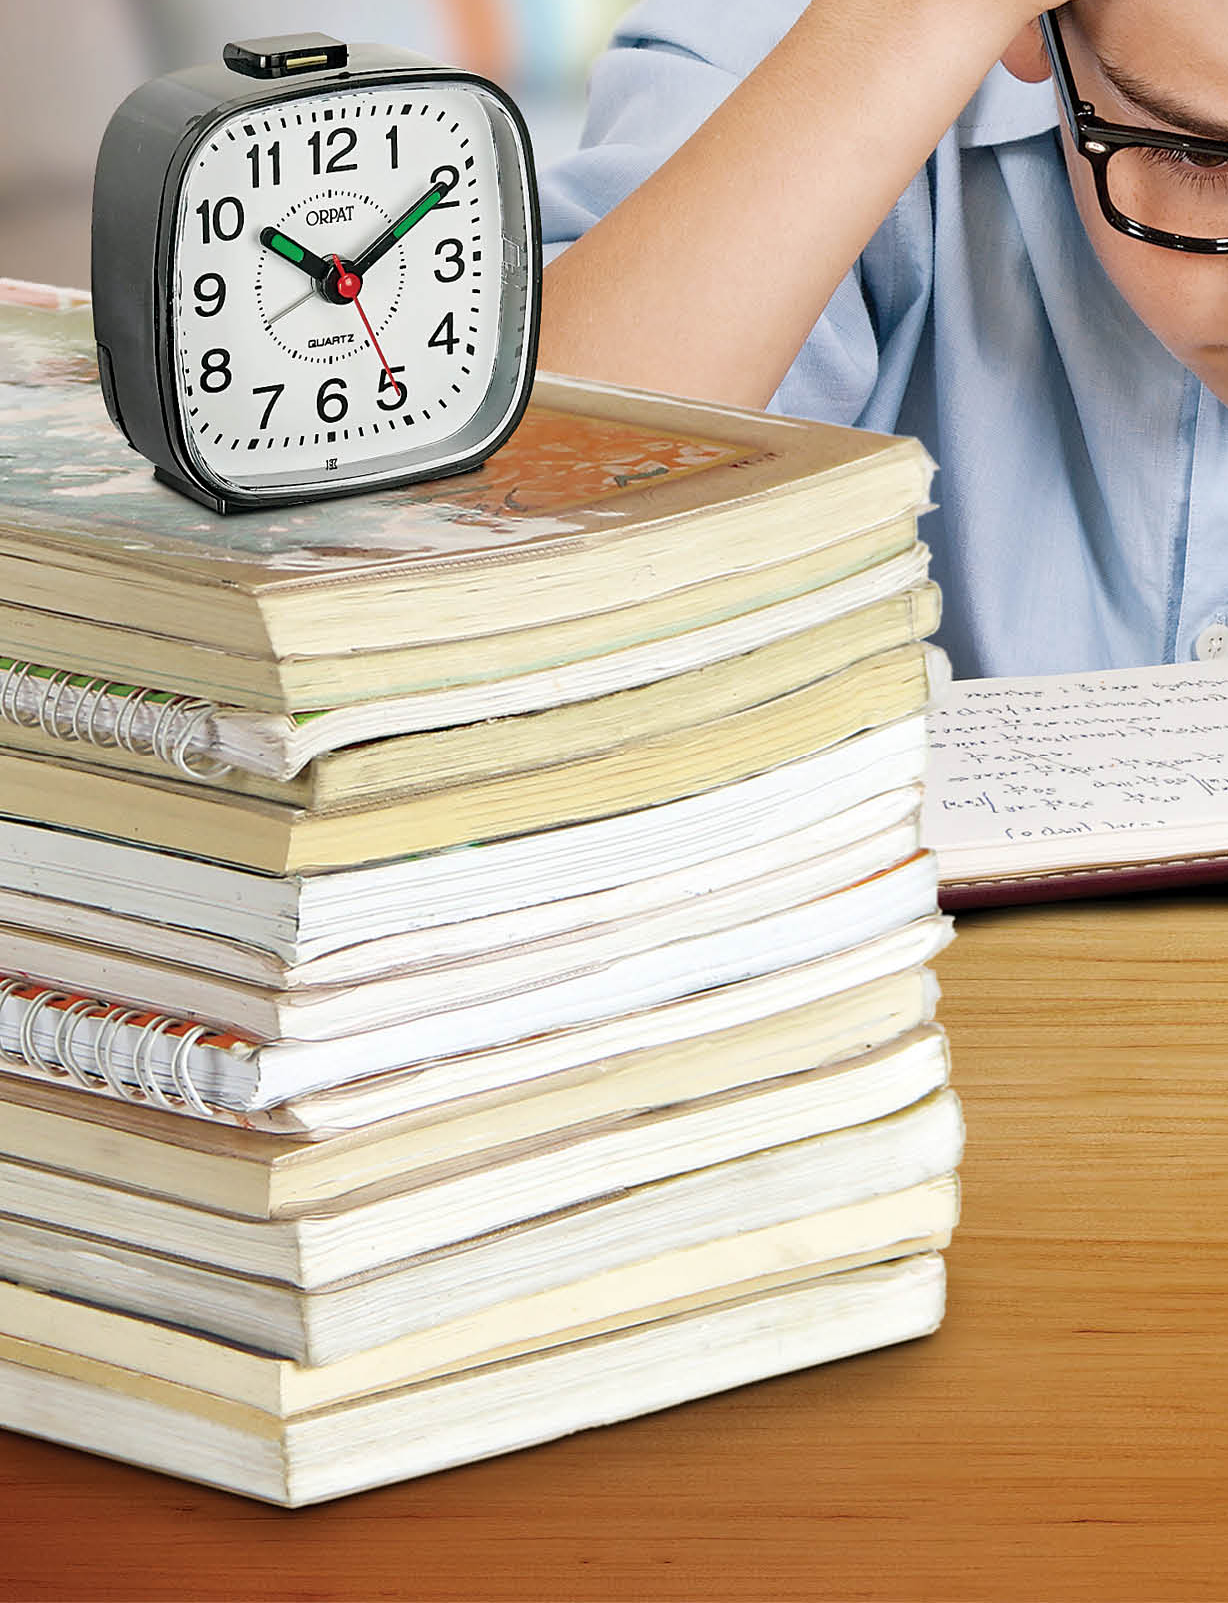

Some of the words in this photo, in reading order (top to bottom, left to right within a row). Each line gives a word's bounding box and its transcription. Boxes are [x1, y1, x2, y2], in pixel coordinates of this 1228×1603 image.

[246, 140, 282, 189] 11
[307, 127, 358, 176] 12
[385, 125, 399, 170] 1
[430, 164, 461, 209] 2
[195, 196, 245, 245] 10
[305, 205, 355, 227] ORPAT
[433, 238, 465, 284] 3
[193, 272, 227, 318] 9
[307, 333, 355, 349] QUARTZ
[427, 311, 460, 356] 4
[199, 347, 232, 394] 8
[376, 365, 408, 412] 5
[252, 383, 285, 430] 7
[316, 377, 349, 424] 6
